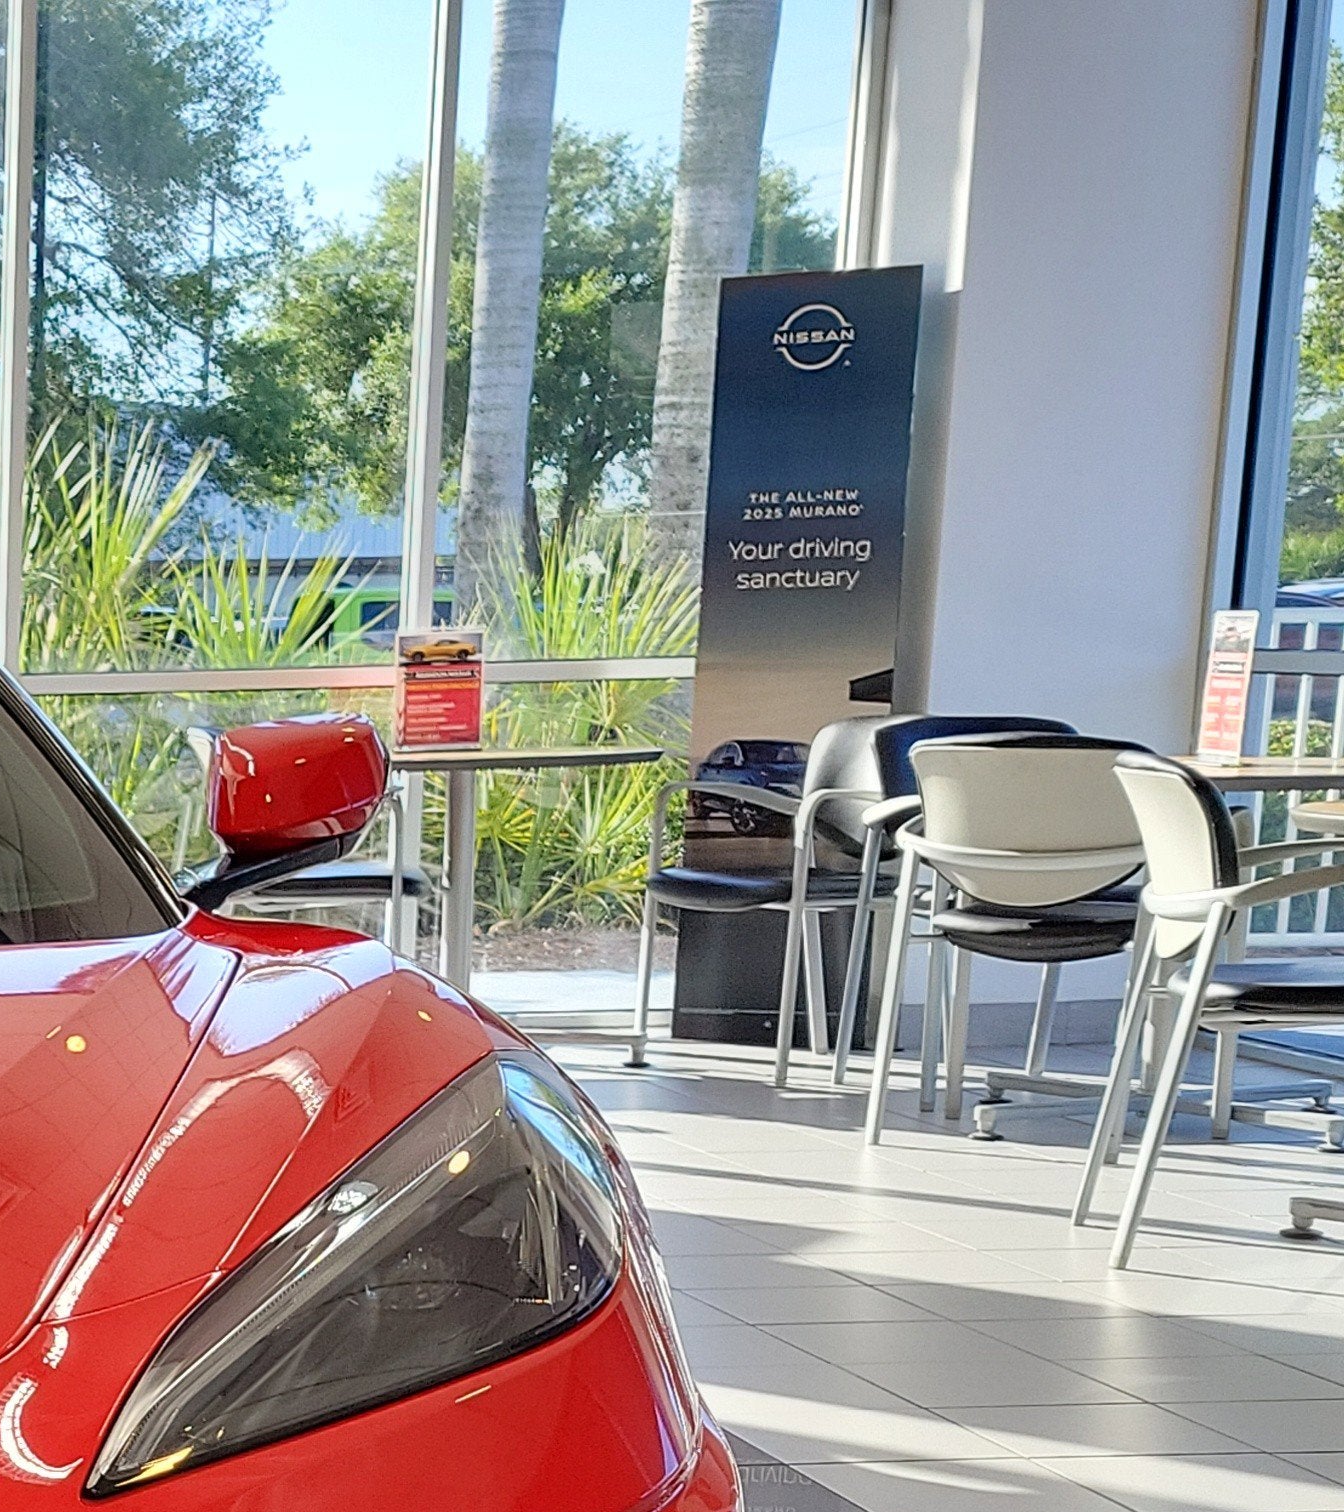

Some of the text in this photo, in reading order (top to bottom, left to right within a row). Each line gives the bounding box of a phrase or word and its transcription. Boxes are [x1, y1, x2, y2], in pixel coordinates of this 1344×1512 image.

[773, 328, 856, 345] NISSAN
[749, 488, 861, 504] THE ALL-NEW
[742, 507, 784, 521] 2025
[728, 536, 872, 563] Your driving
[736, 568, 861, 592] sanctuary
